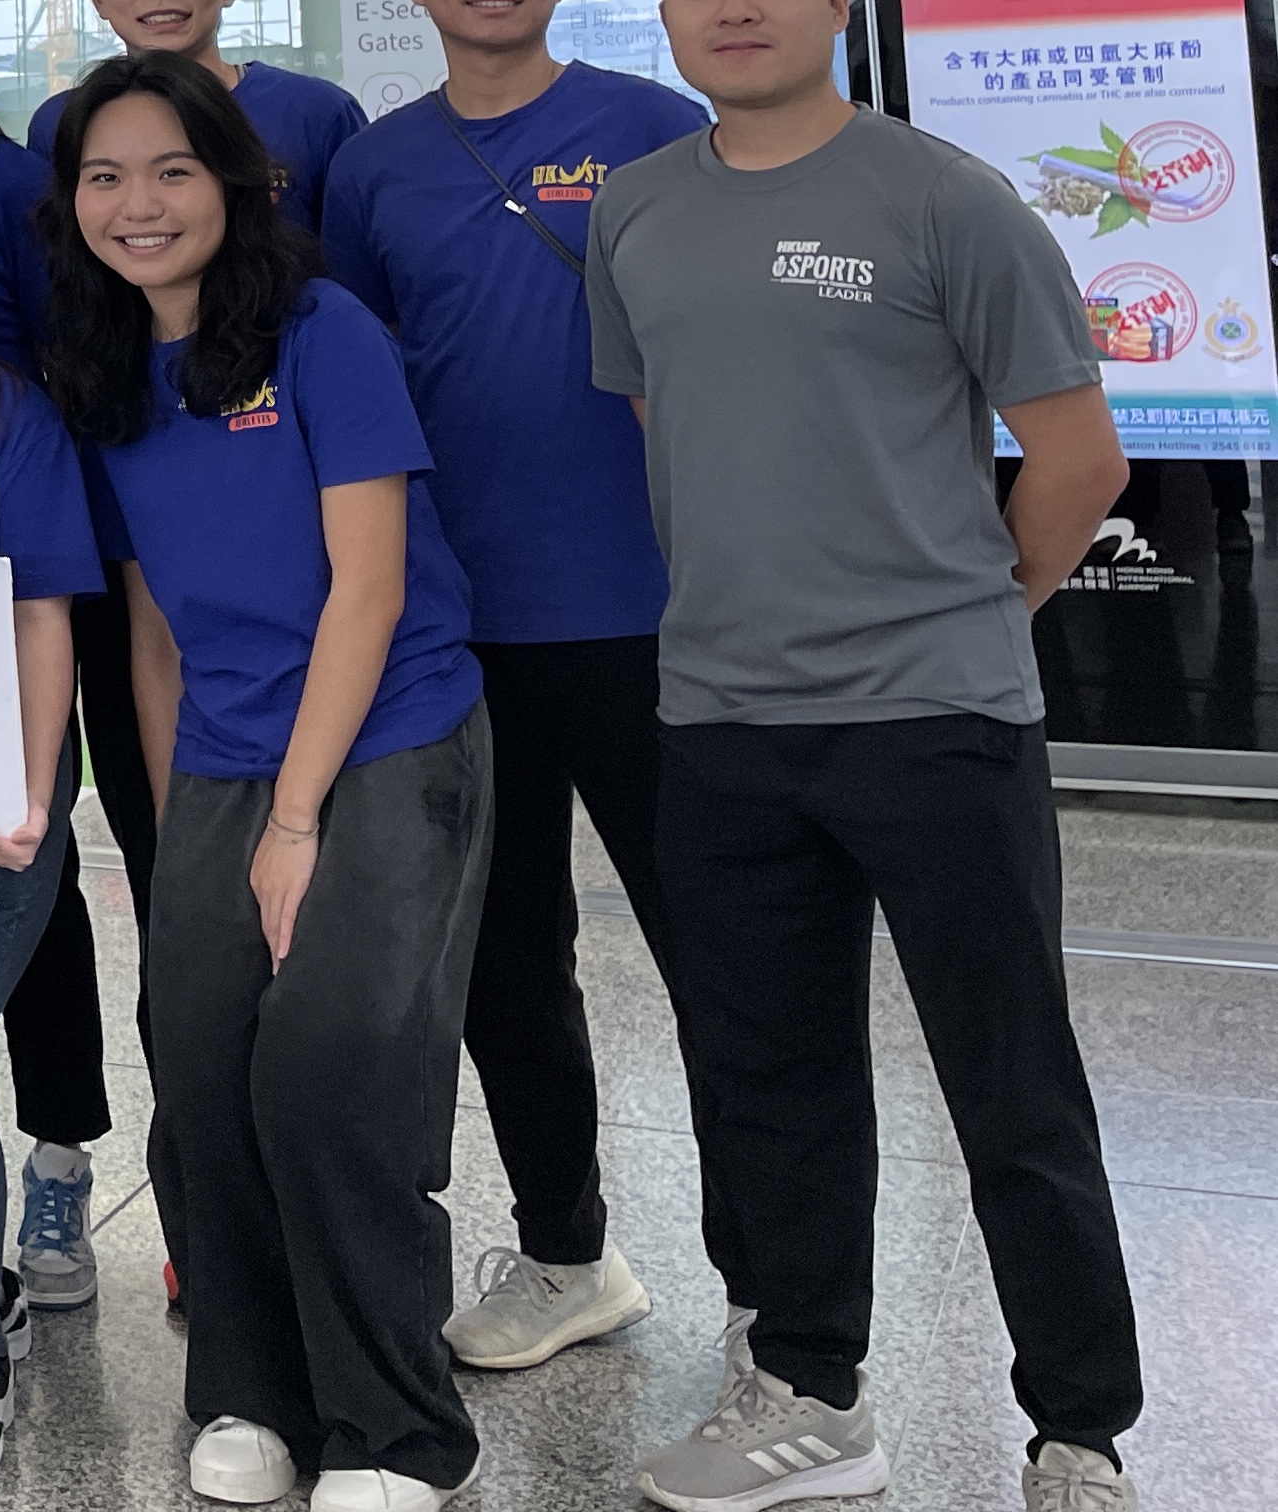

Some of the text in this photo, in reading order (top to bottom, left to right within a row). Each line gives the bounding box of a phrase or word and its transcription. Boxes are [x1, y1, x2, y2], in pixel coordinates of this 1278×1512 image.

[358, 33, 423, 53] Gates
[776, 240, 821, 254] HKUST
[787, 254, 874, 286] SPORTS
[819, 286, 873, 303] LEADER
